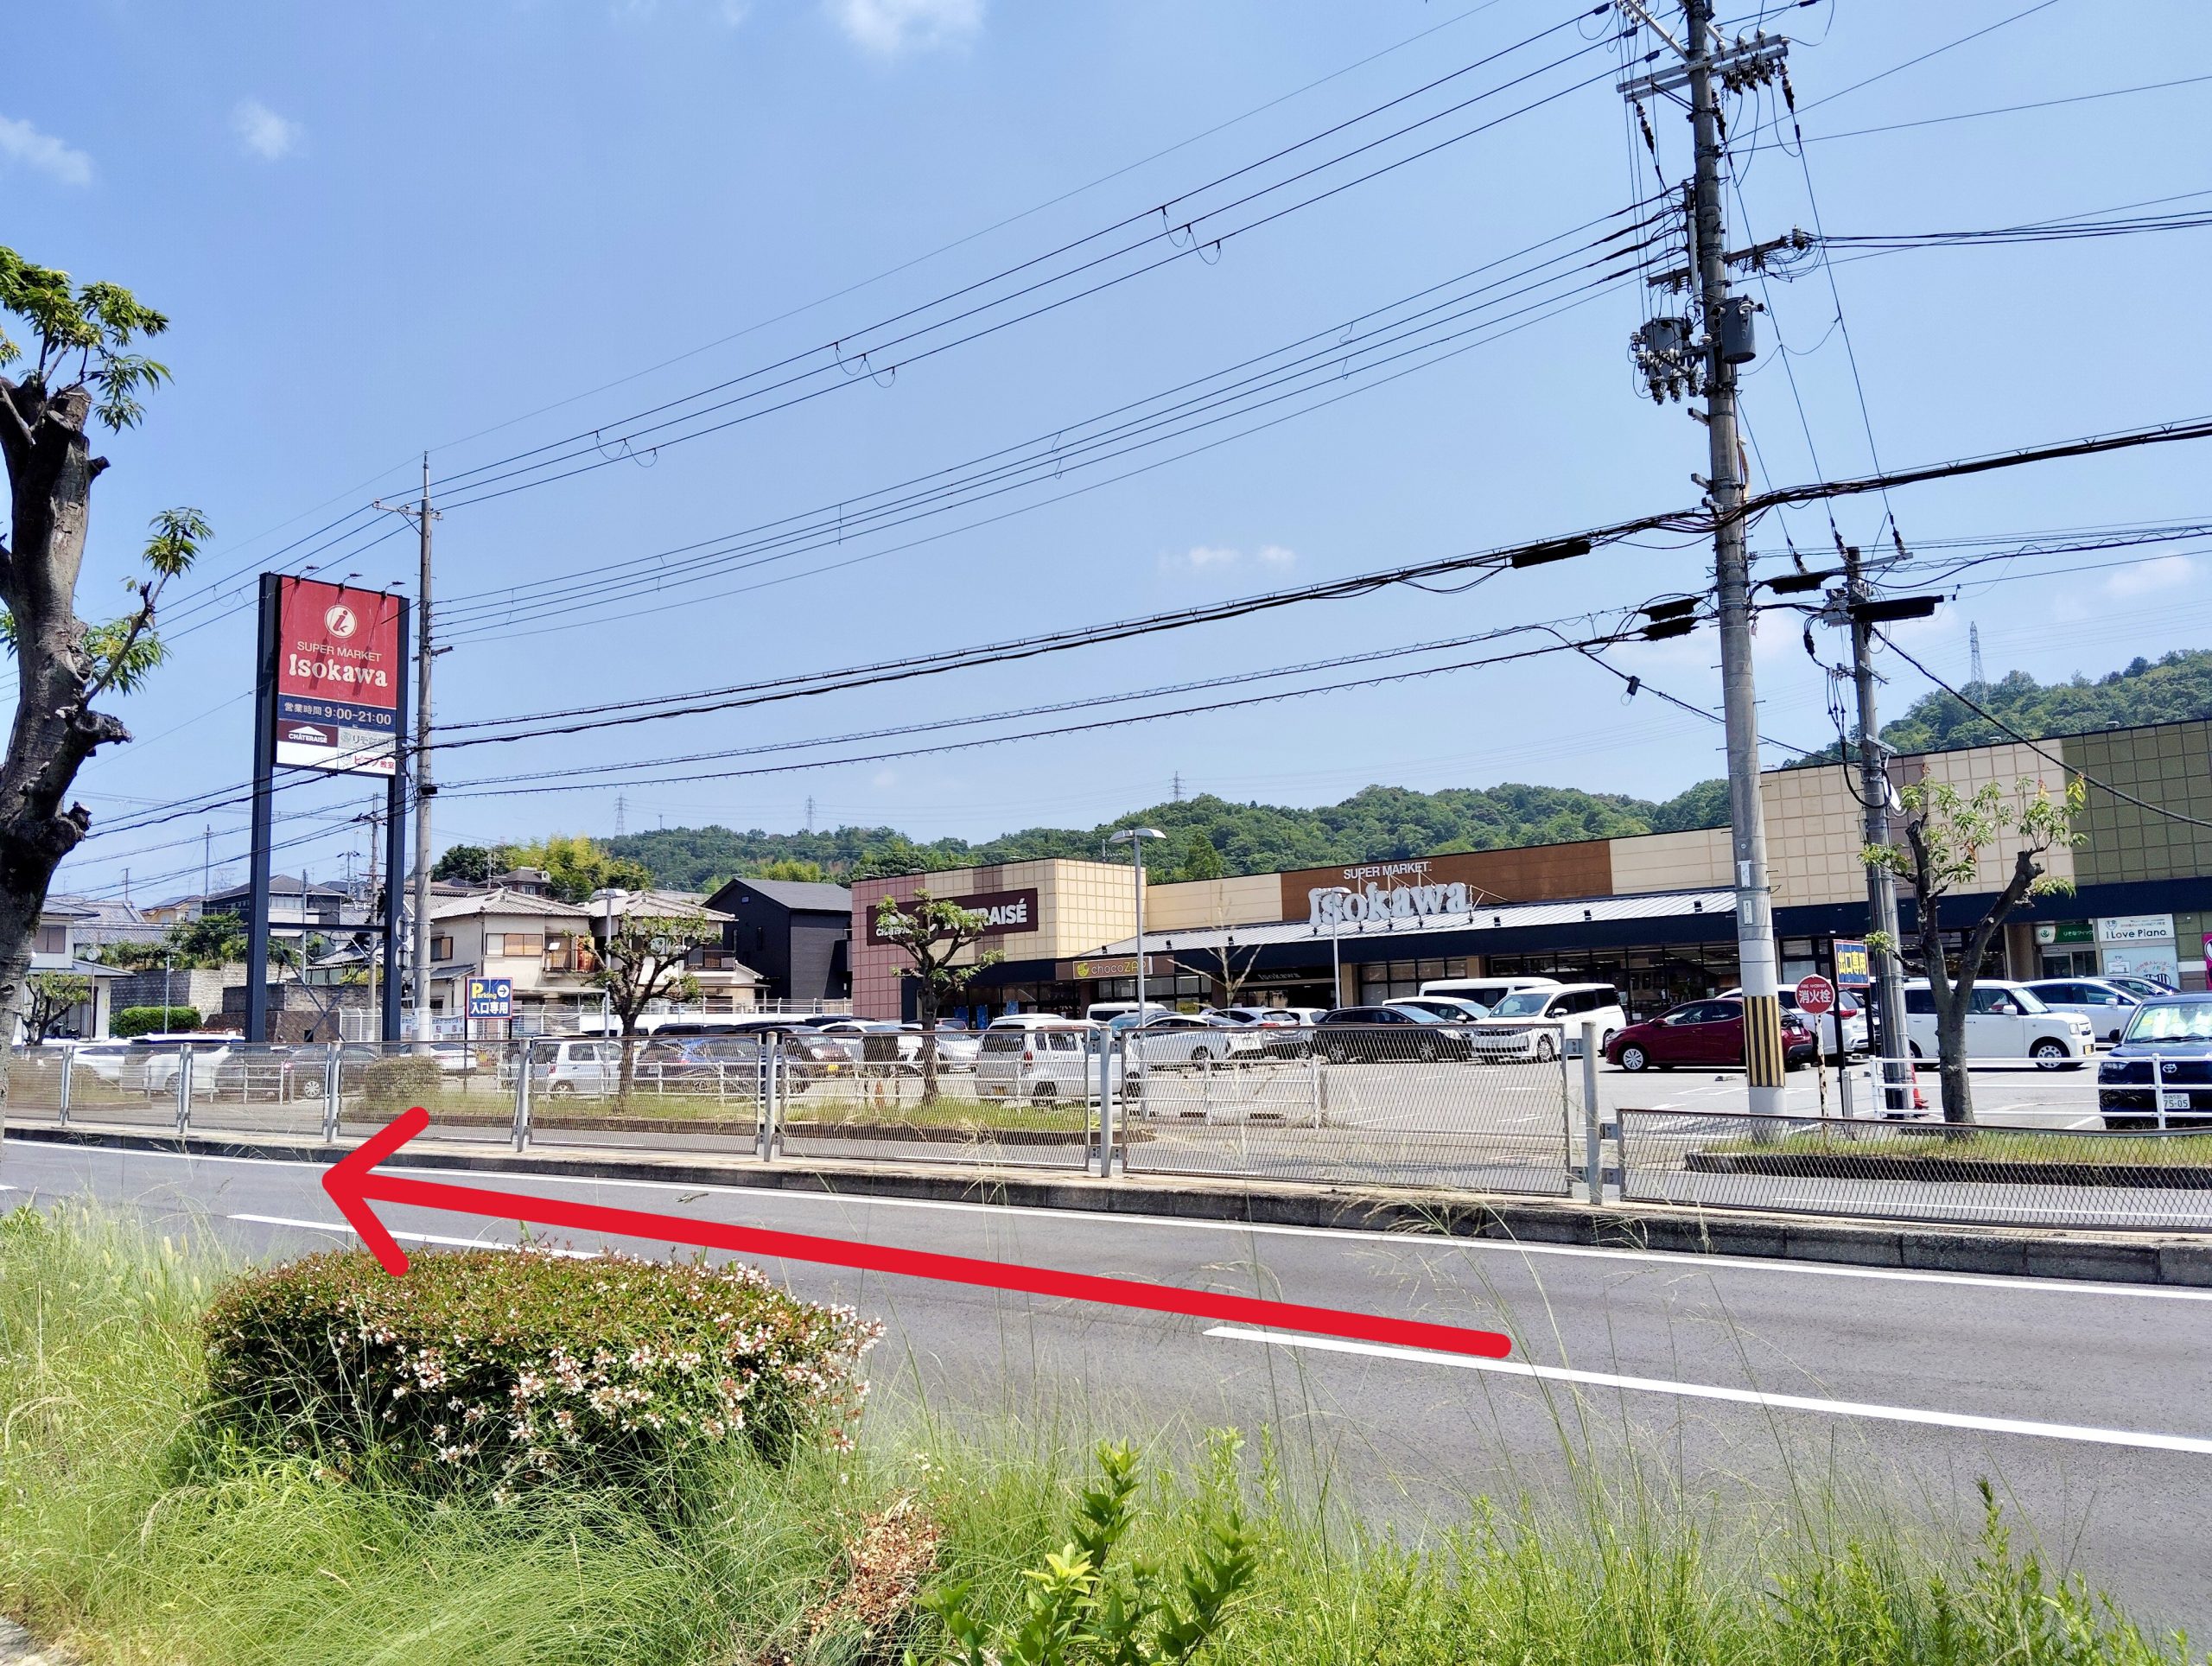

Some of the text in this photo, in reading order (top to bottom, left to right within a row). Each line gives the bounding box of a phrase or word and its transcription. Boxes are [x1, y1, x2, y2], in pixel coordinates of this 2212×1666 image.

[297, 641, 382, 663] SUPER MARKET
[289, 653, 388, 688] Isokawa
[284, 702, 322, 716] 営業時間
[1343, 861, 1429, 880] SUPER MARKET
[1308, 881, 1471, 928] Isokawa
[2111, 930, 2135, 939] Love
[1837, 951, 1866, 975] 出口専用
[471, 982, 497, 1000] Parking
[1798, 989, 1832, 1004] 消火栓
[470, 1002, 509, 1014] 入口専用
